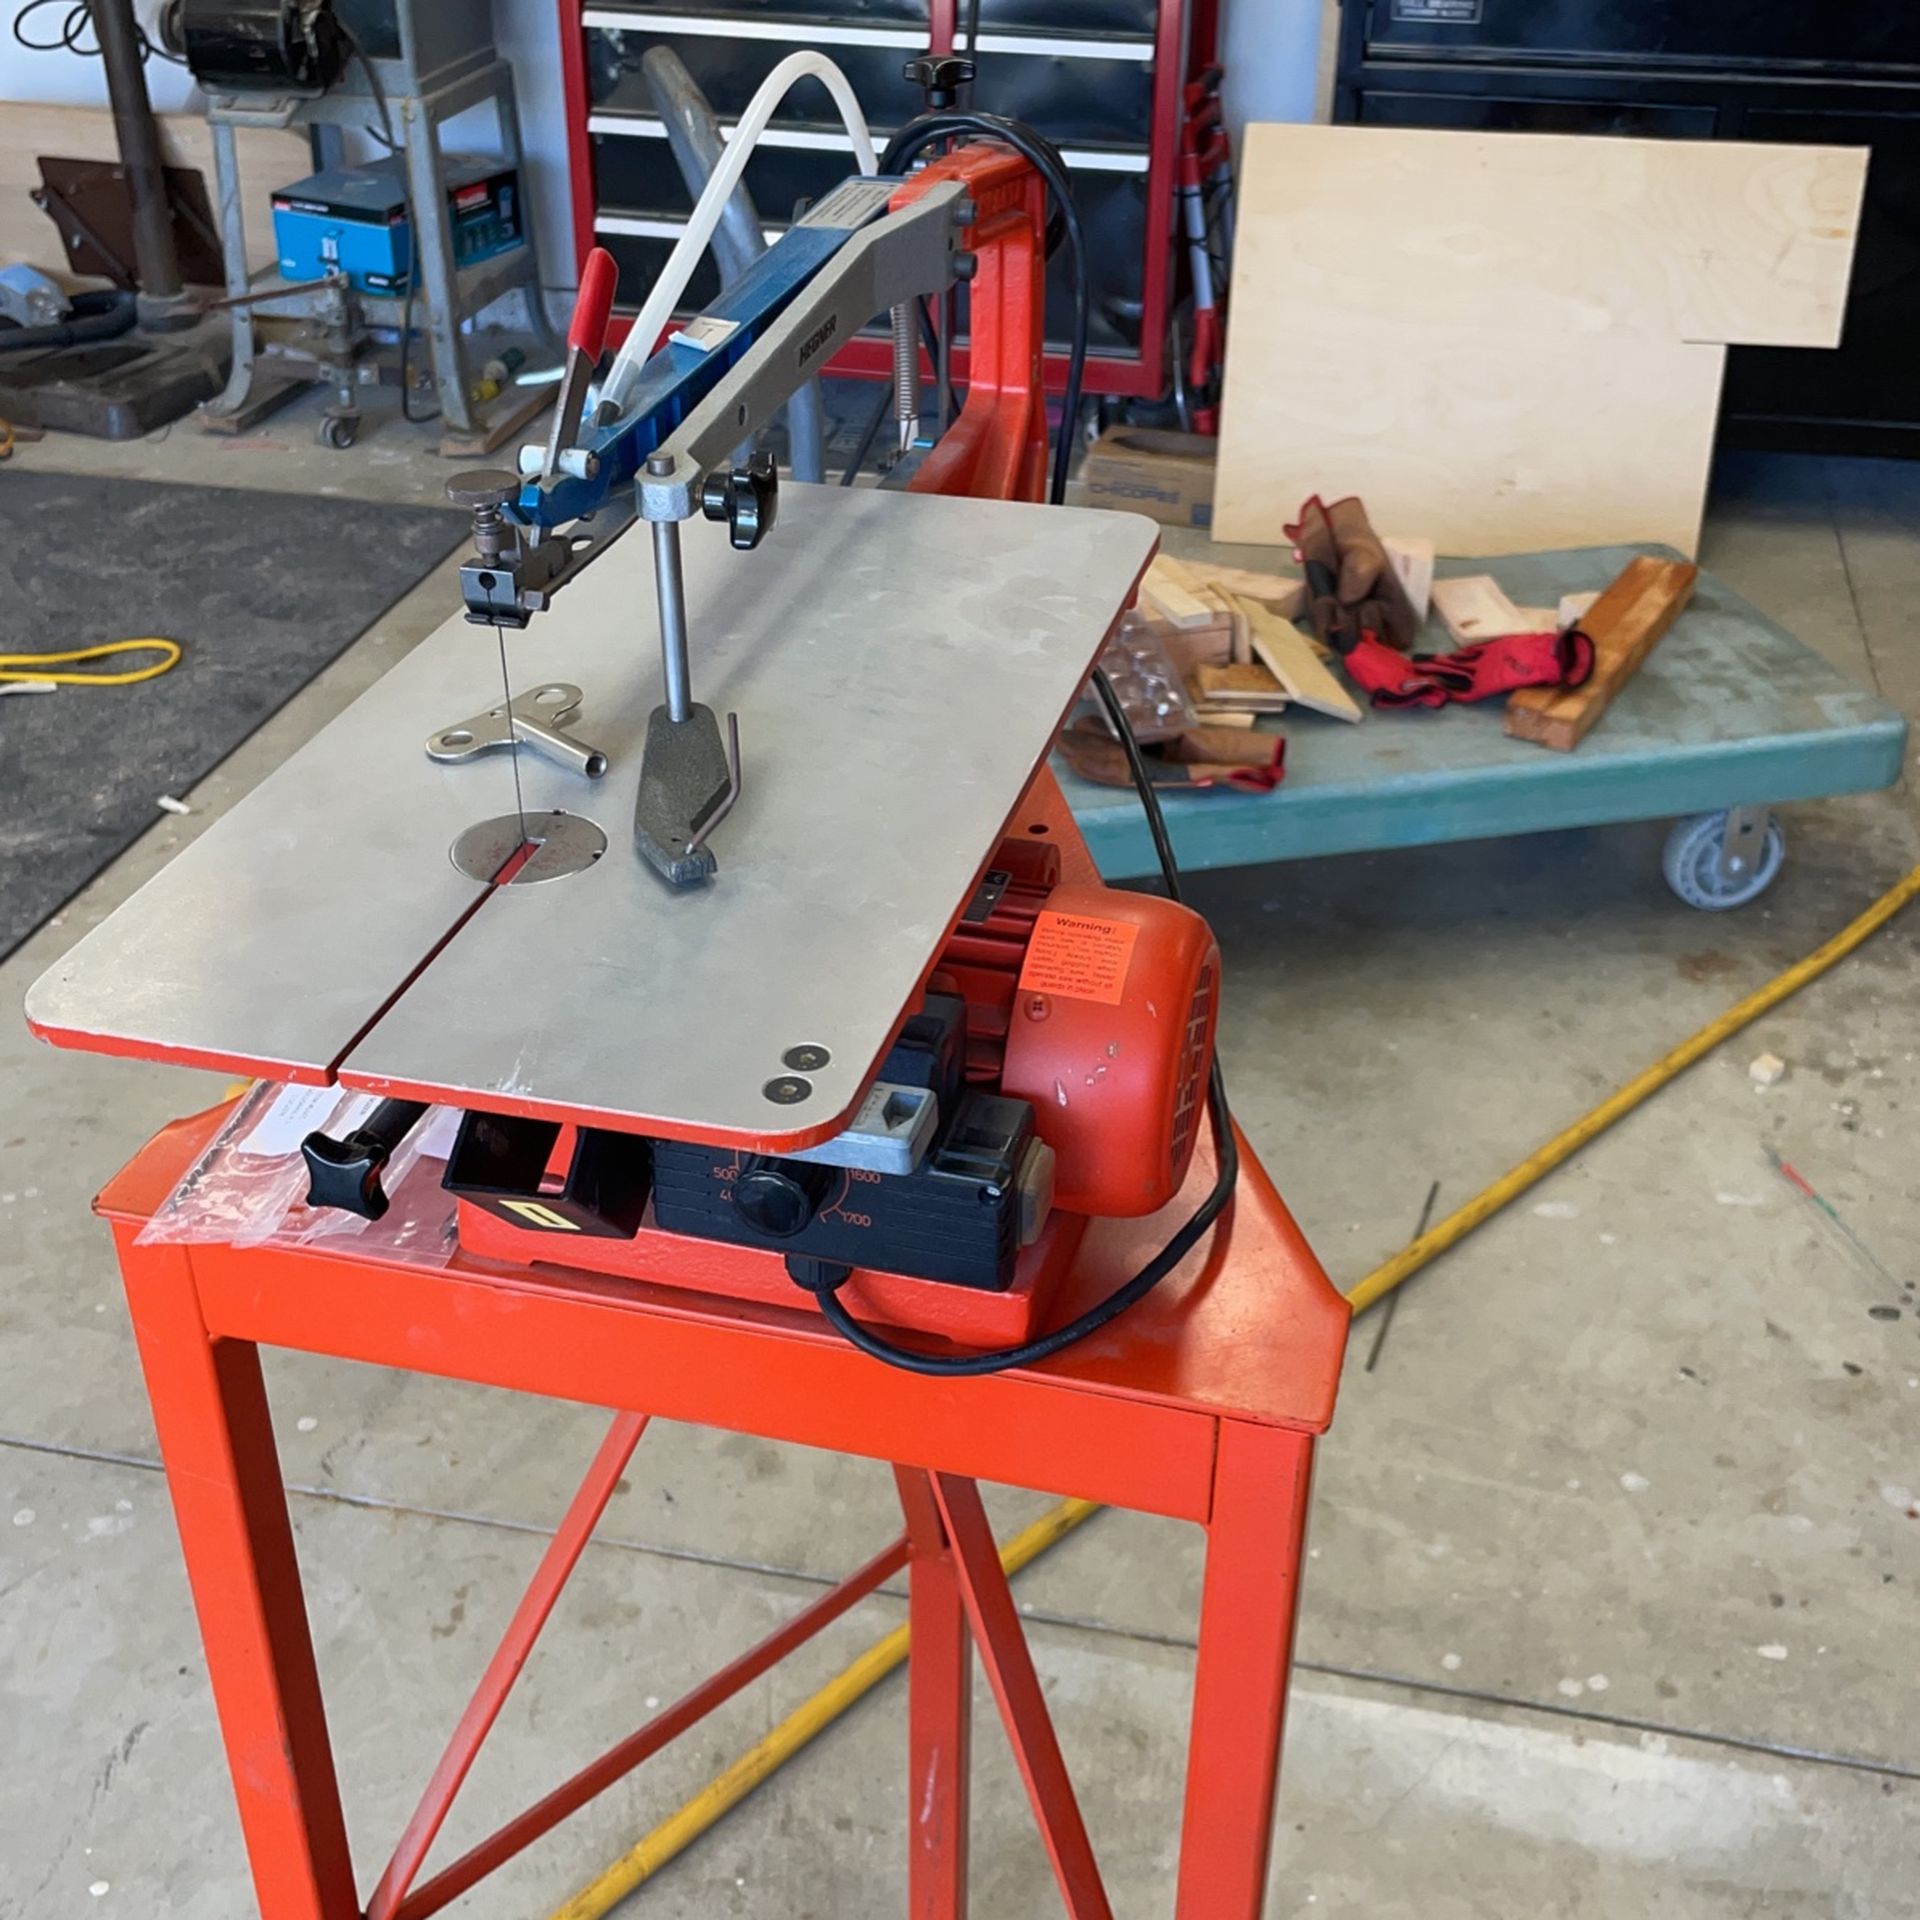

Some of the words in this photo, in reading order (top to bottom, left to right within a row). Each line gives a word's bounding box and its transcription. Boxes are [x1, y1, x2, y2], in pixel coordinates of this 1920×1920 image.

[799, 314, 837, 368] HEGNER
[713, 1166, 738, 1182] 500
[843, 1213, 872, 1227] 1700
